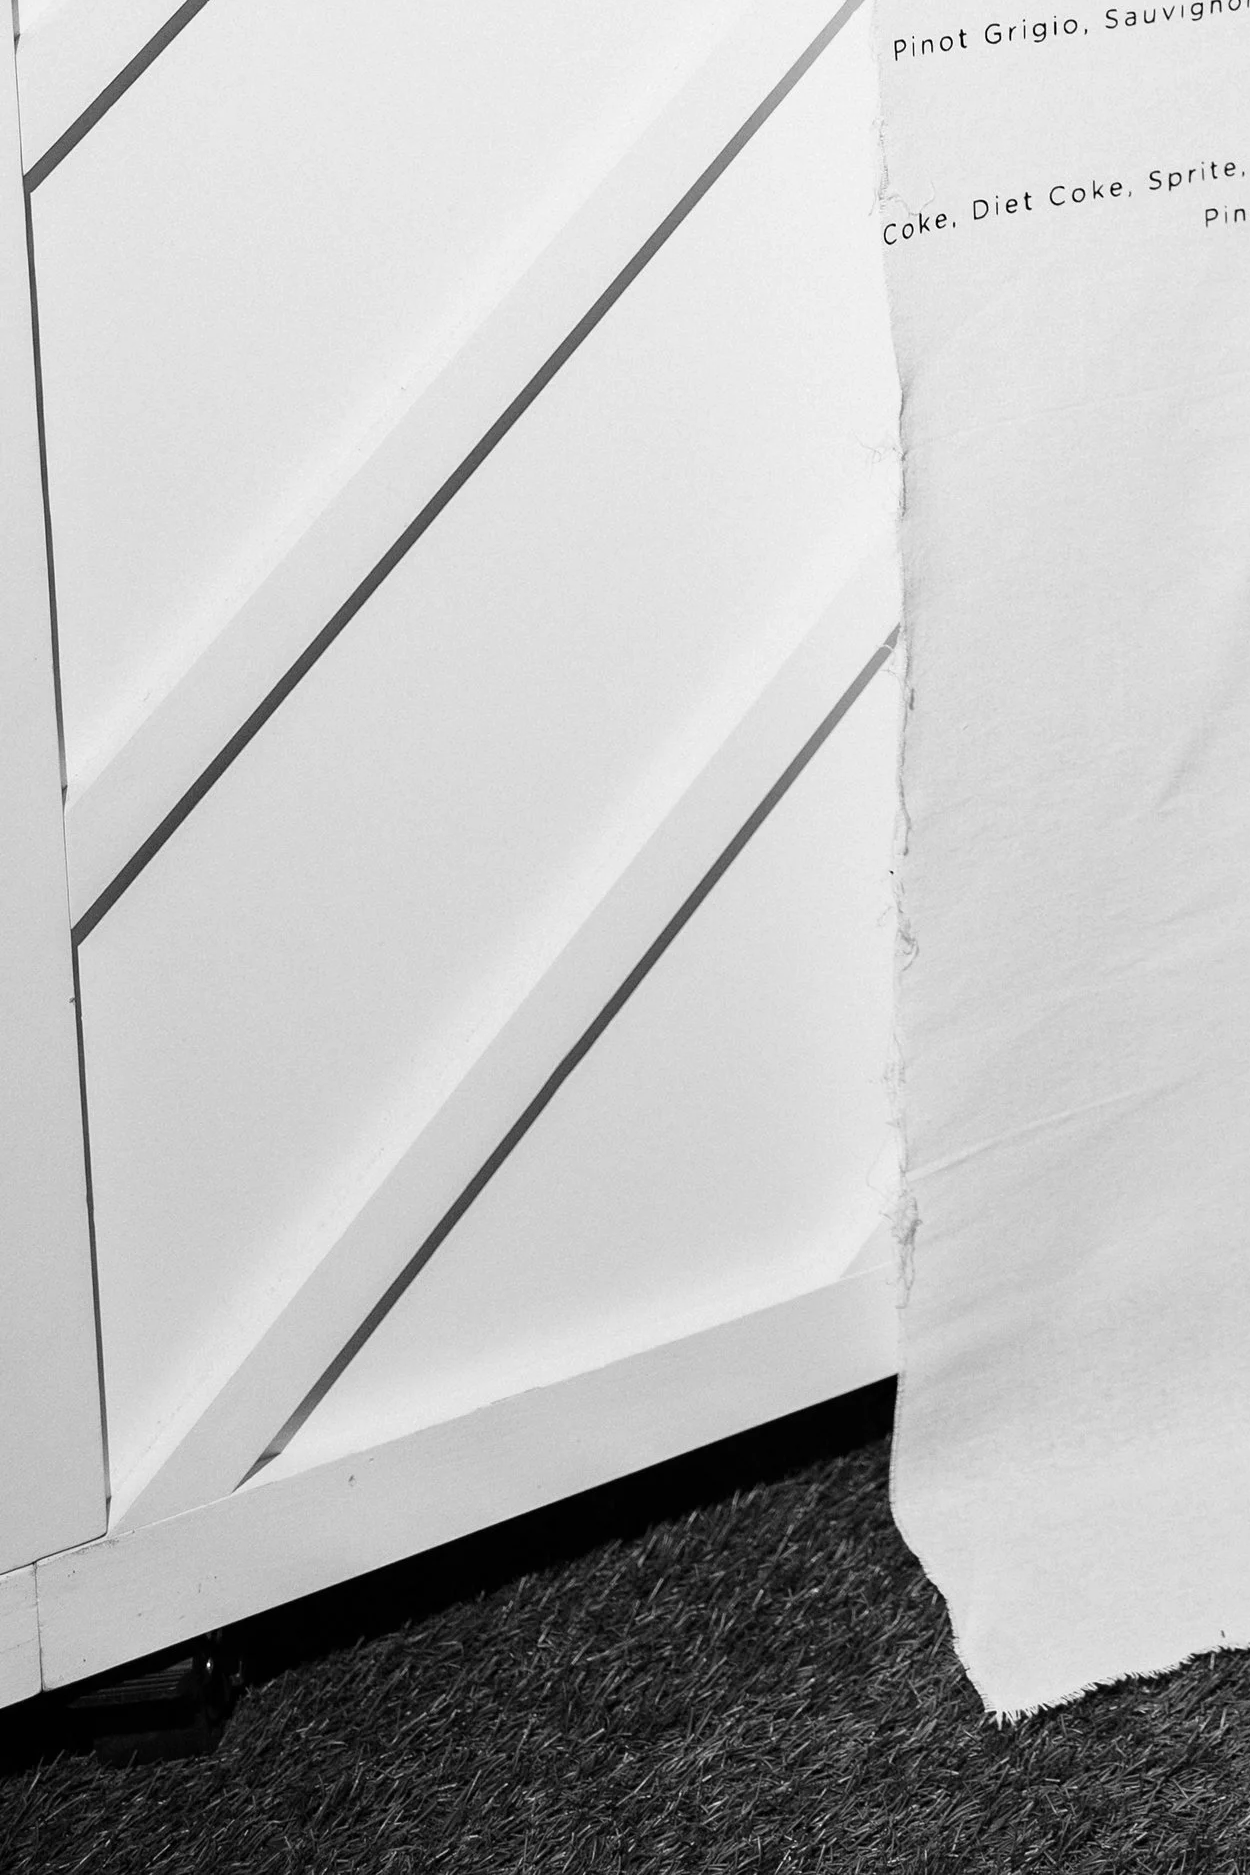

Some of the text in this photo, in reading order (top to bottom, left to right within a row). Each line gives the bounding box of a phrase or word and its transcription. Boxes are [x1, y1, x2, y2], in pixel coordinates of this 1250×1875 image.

[893, 28, 968, 62] Pinot
[984, 15, 1088, 46] Grigio,
[883, 212, 956, 246] Coke,
[972, 191, 1033, 221] Diet
[1048, 179, 1132, 207] Coke,
[1148, 160, 1246, 192] Sprite,
